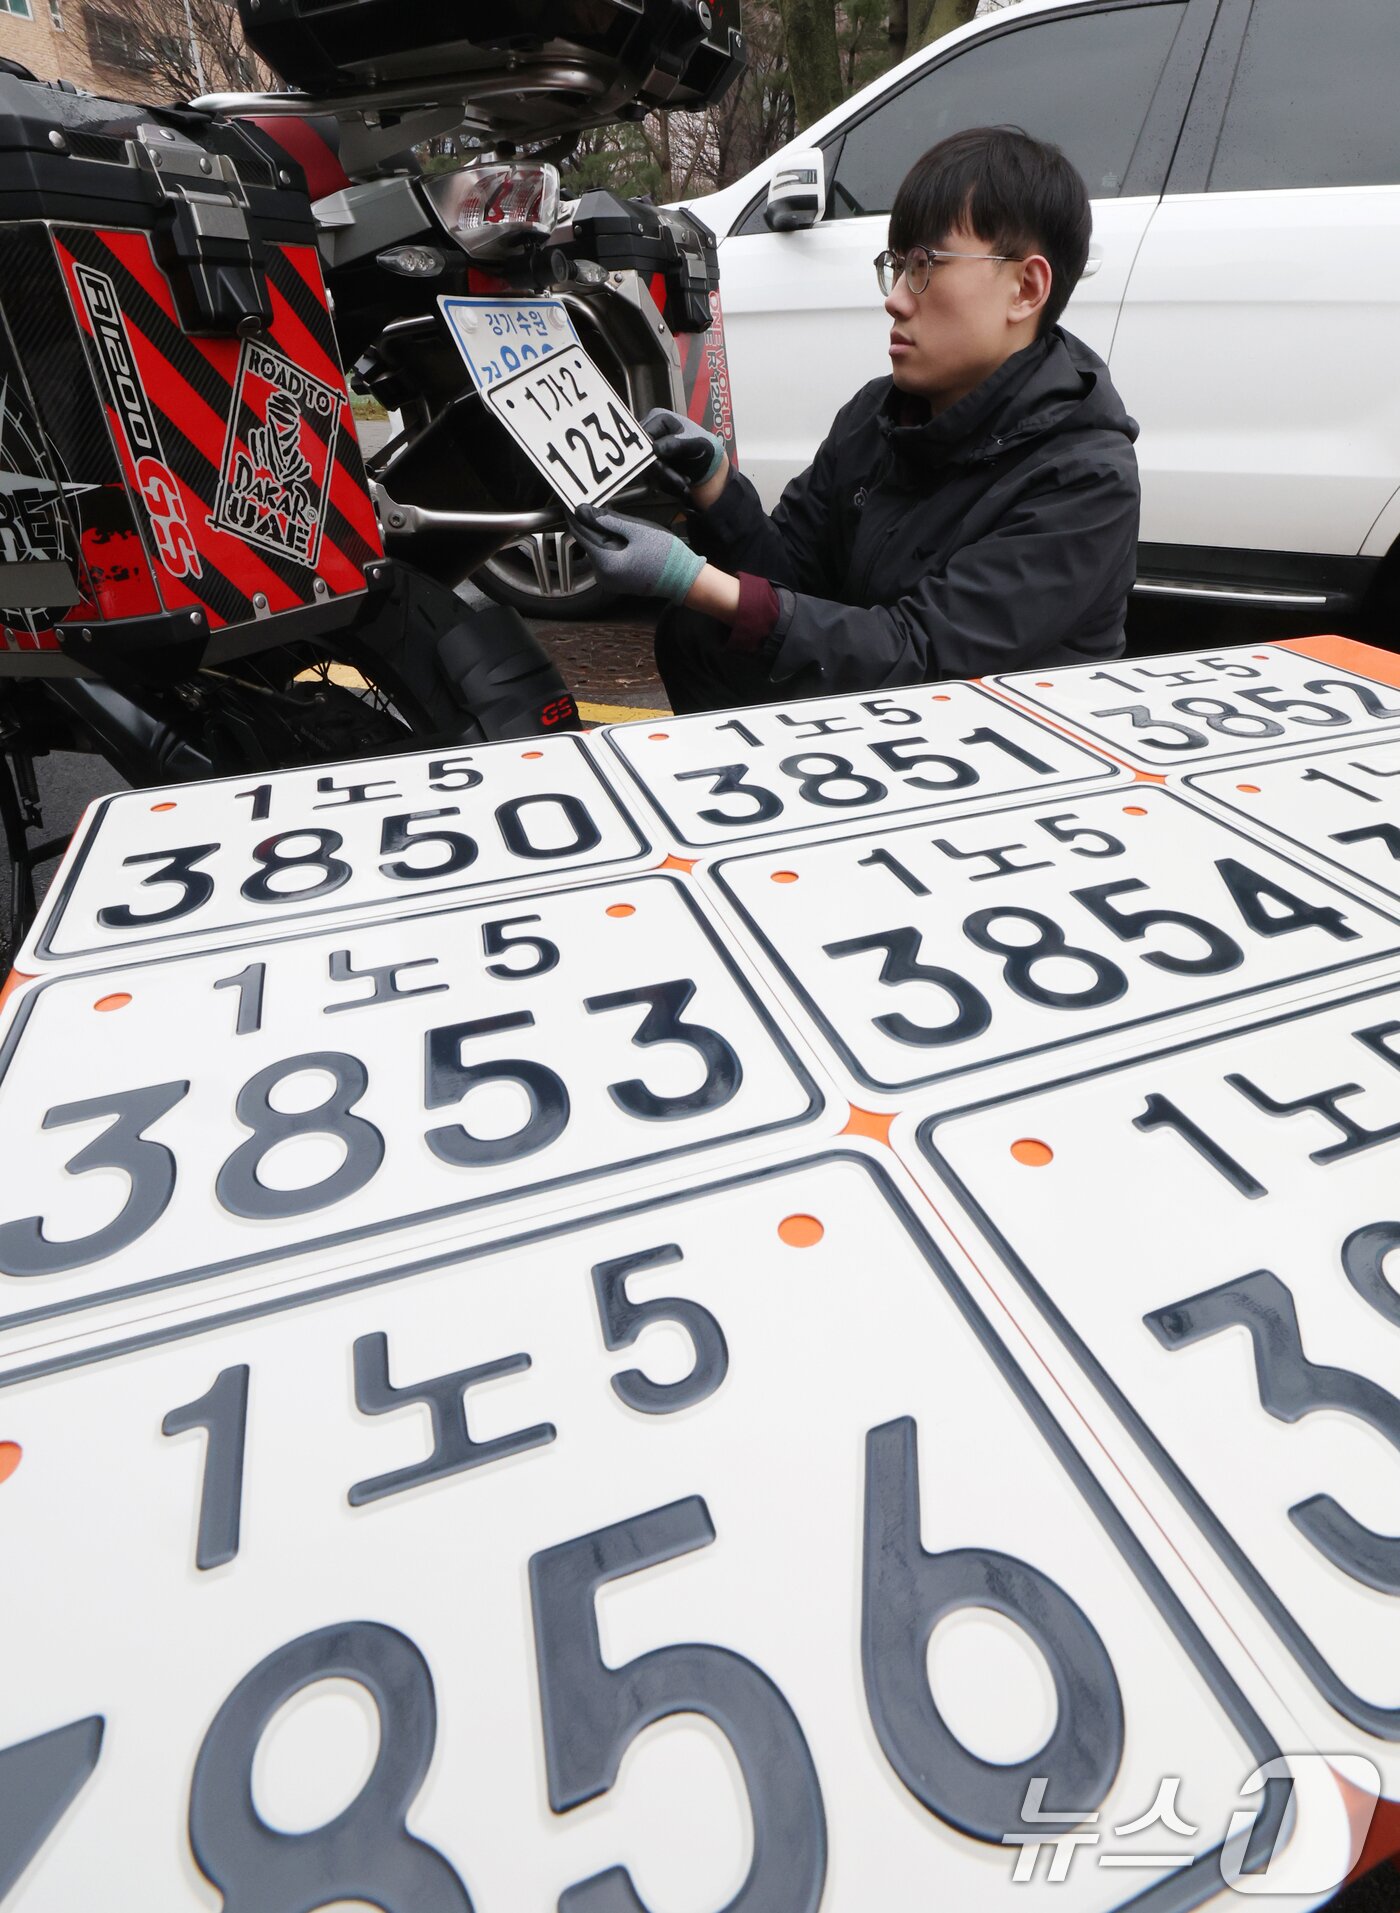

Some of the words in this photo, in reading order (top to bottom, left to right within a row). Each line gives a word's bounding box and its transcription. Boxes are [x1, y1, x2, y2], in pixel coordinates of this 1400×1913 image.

[247, 347, 302, 397] ROAD
[303, 380, 331, 415] TO
[525, 367, 588, 421] 1가2
[709, 290, 723, 346] ONE
[716, 348, 733, 441] WORLD
[234, 452, 311, 528] DAKAR
[546, 401, 644, 495] 1234
[136, 456, 202, 579] GS
[226, 497, 310, 555] UAE
[542, 697, 572, 726] GS
[1090, 679, 1400, 750] 3852
[674, 726, 1060, 827] 3851
[97, 793, 602, 929] 3850
[821, 857, 1364, 1048] 3854
[0, 978, 743, 1278] 3853
